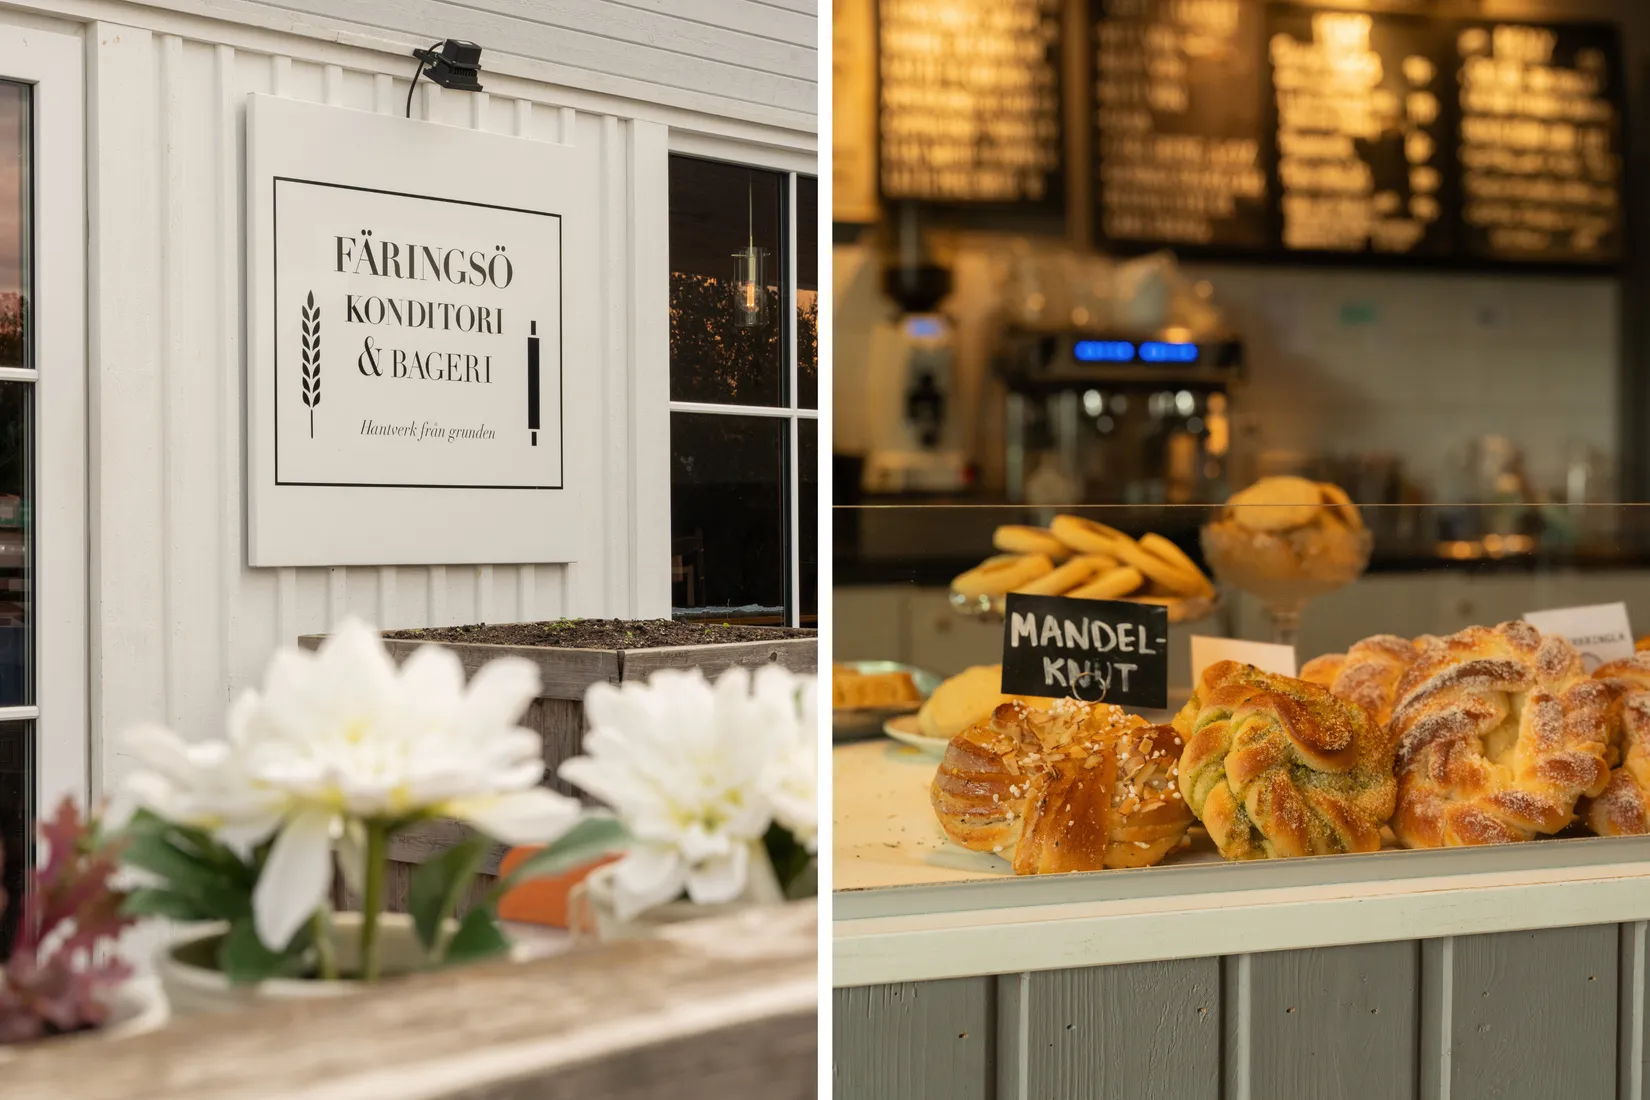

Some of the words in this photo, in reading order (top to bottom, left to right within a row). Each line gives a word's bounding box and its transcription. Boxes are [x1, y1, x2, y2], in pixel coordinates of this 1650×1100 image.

[334, 229, 513, 289] FÄRINGSÖ
[345, 294, 504, 335] KONDITORI
[357, 335, 384, 377] &
[390, 349, 493, 384] BAGERI
[360, 419, 417, 437] Hantverk
[417, 421, 446, 441] från
[447, 423, 496, 443] grunden
[1011, 612, 1167, 654] MANDEL-
[1042, 657, 1138, 692] KNUT
